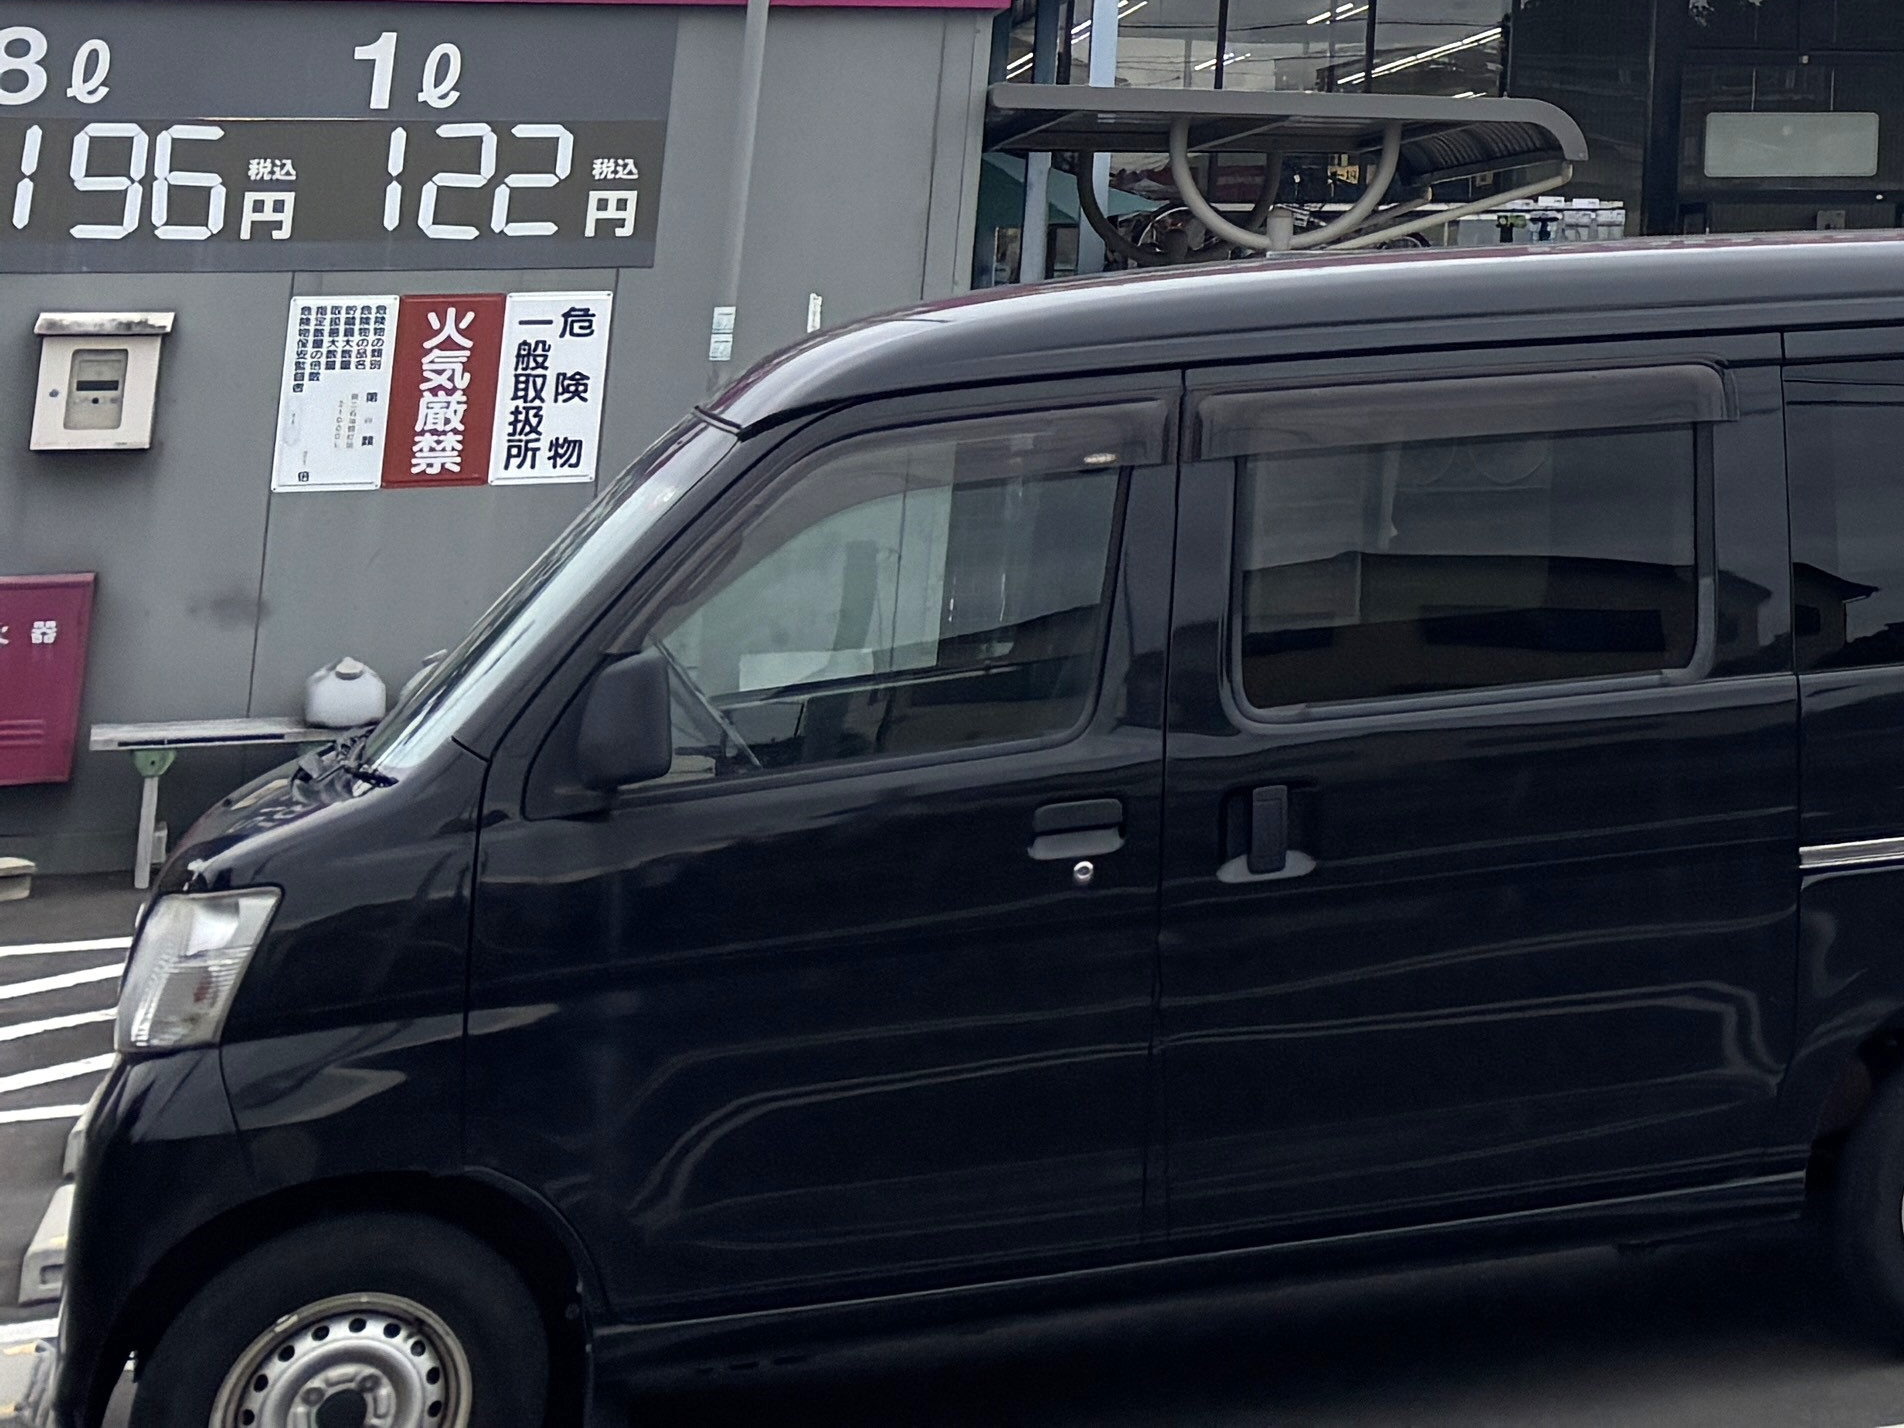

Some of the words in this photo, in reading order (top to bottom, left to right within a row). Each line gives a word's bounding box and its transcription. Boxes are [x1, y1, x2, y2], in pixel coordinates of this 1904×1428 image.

[248, 159, 297, 182] 税込
[383, 122, 575, 240] 122
[591, 158, 639, 181] 税込
[240, 191, 296, 240] 円
[584, 190, 638, 238] 円
[410, 306, 476, 475] 火気厳禁
[503, 319, 554, 471] 一般取扱所
[546, 306, 597, 469] 危険物
